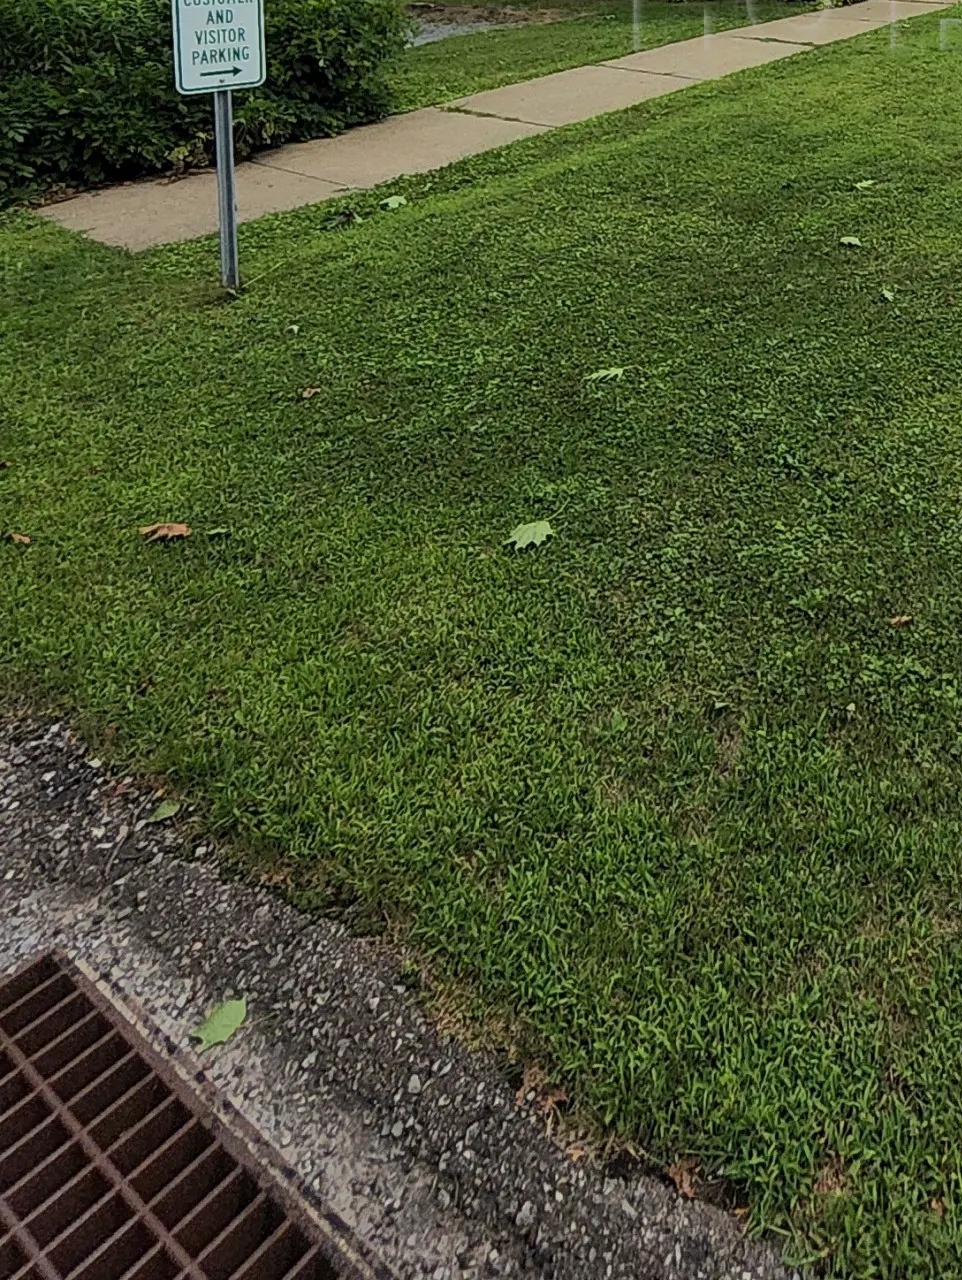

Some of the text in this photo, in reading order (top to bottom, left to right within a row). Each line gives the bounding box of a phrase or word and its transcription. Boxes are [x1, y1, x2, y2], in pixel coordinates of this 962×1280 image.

[206, 9, 234, 26] AND
[194, 27, 246, 45] VISITOR
[191, 46, 250, 66] PARKING
